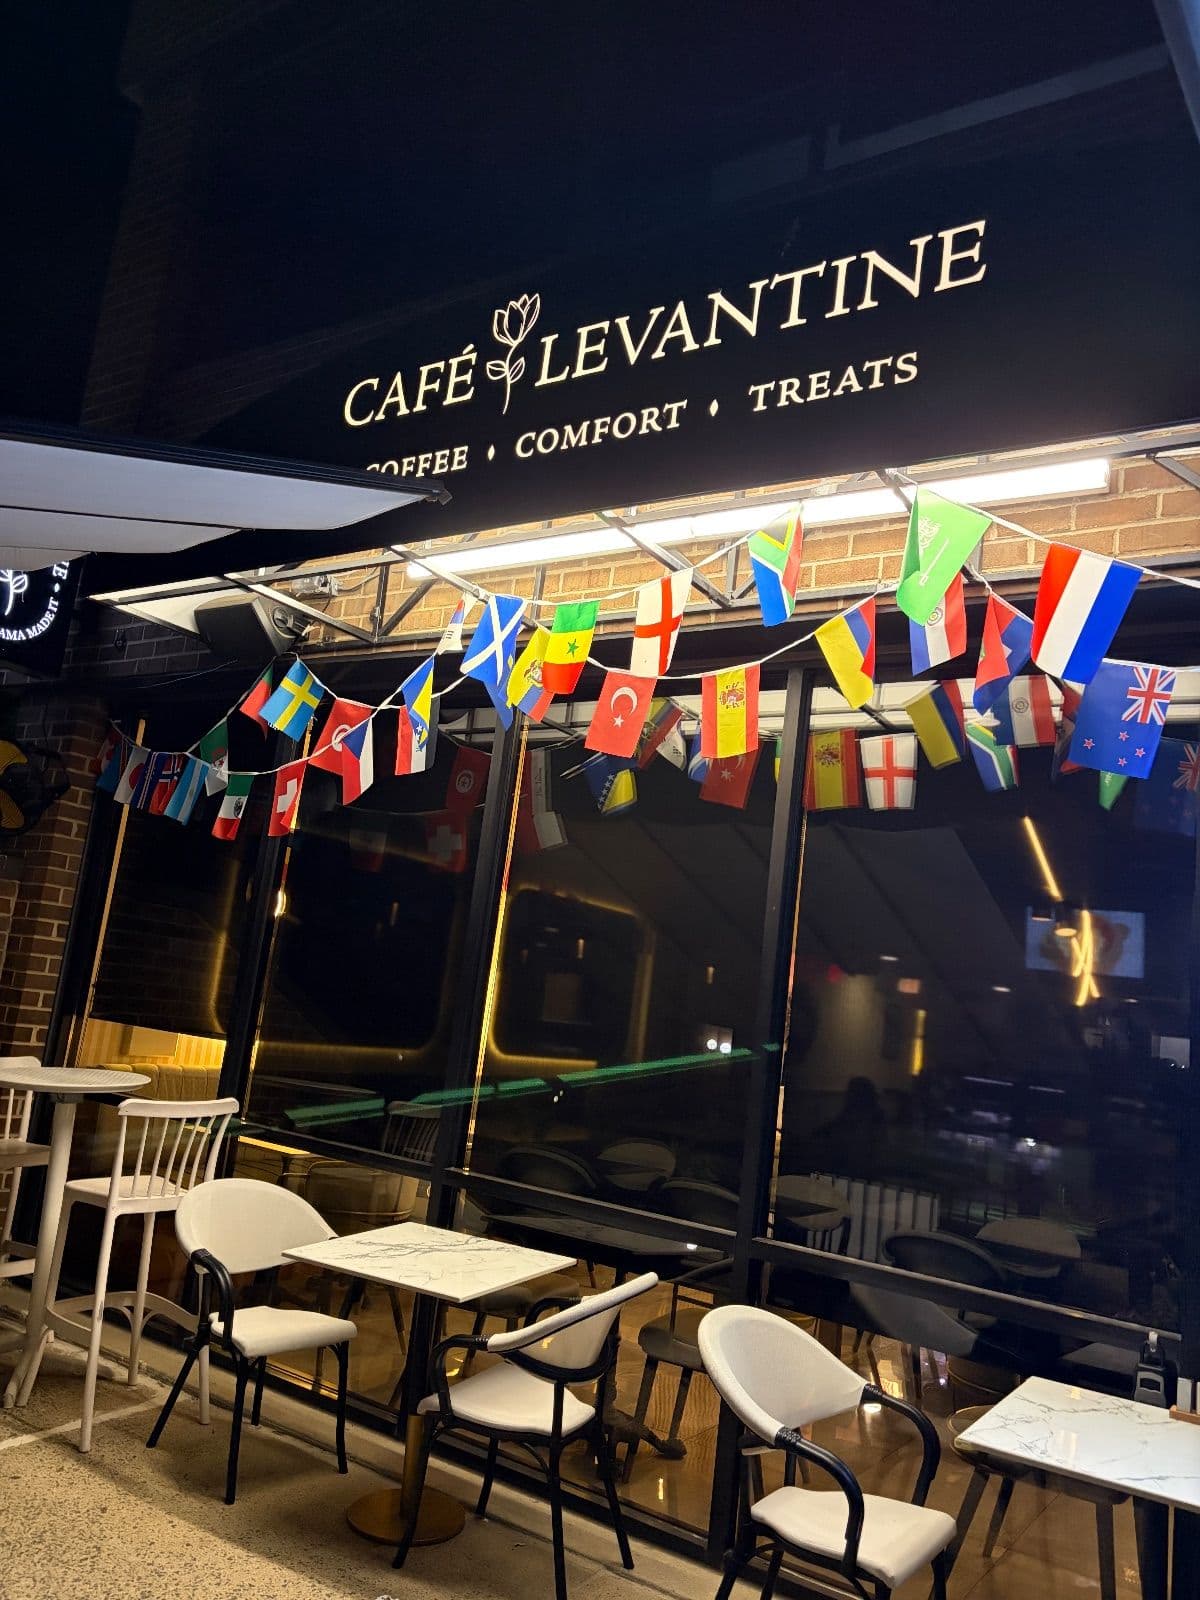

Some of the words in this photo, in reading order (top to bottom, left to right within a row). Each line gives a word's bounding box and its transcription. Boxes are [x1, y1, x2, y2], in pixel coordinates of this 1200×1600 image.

[343, 343, 478, 429] CAFÉ
[534, 219, 988, 388] LEVANTINE
[515, 399, 689, 459] COMFORT
[748, 351, 919, 412] TREATS
[26, 610, 56, 639] MADE
[48, 596, 59, 613] IT
